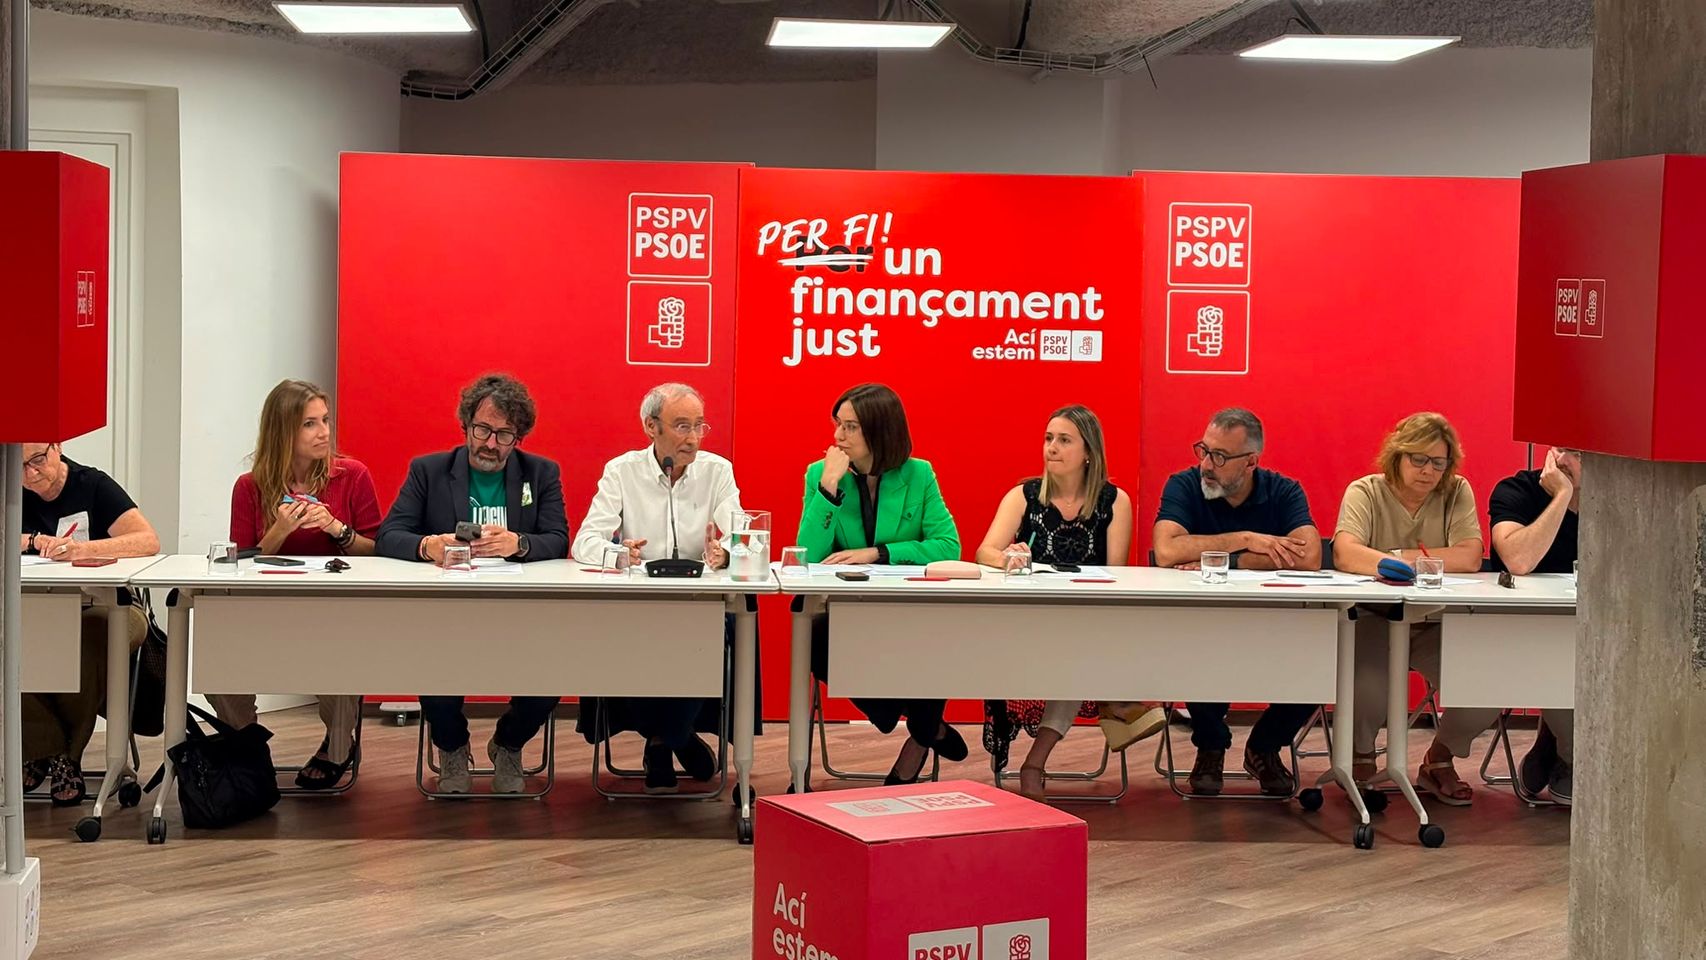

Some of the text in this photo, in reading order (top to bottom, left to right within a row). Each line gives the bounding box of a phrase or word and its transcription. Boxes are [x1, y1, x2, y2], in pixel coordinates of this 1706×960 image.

[636, 206, 707, 229] PSPV
[1176, 215, 1246, 238] PSPV
[757, 211, 893, 256] PER FI!
[635, 232, 705, 259] PSOE
[1175, 241, 1244, 267] PSOE
[884, 247, 942, 275] un
[791, 276, 1104, 327] finançament
[1558, 288, 1578, 303] PSPV
[1557, 305, 1577, 323] PSOE
[782, 317, 881, 366] just
[1004, 328, 1037, 345] Ací
[1043, 335, 1068, 345] PSPV
[972, 345, 1035, 360] estem
[1043, 345, 1068, 355] PSOE
[773, 882, 807, 929] Ací
